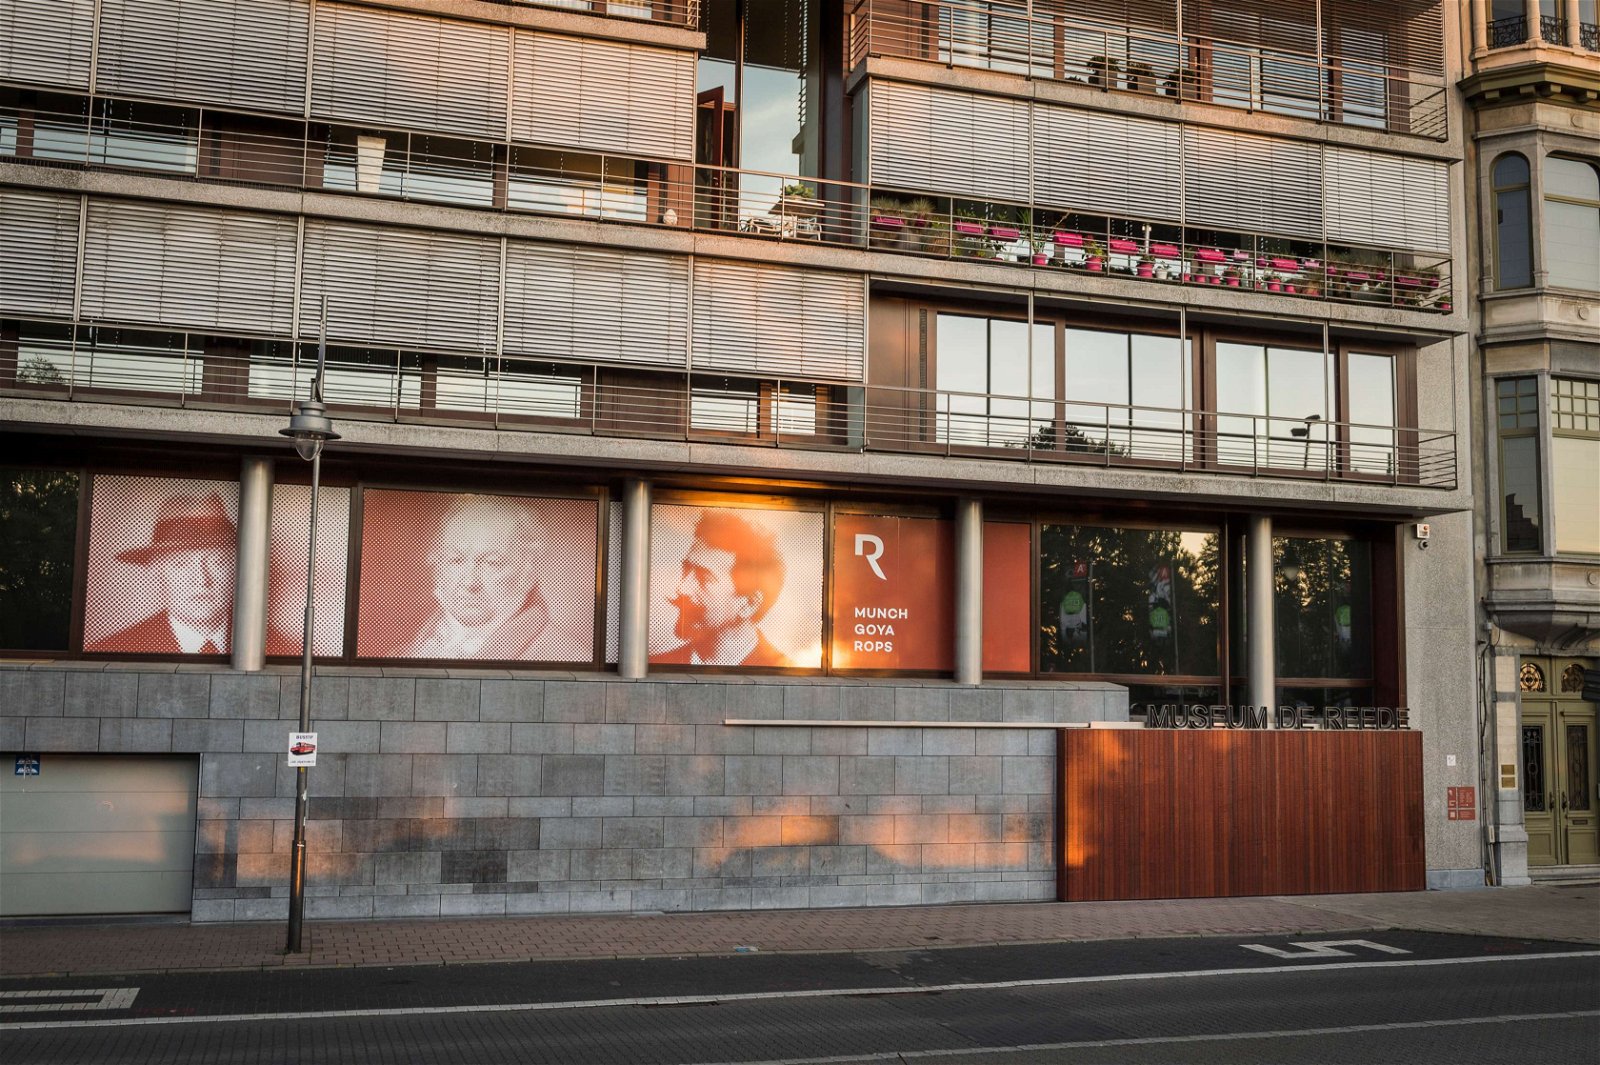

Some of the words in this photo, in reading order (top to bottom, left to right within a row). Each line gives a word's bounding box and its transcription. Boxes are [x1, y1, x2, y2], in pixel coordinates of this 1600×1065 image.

[855, 534, 887, 580] R
[854, 607, 908, 619] MUNCH
[854, 624, 895, 636] GOYA
[854, 640, 893, 653] ROPS
[1147, 704, 1268, 729] MUSEUM
[1277, 705, 1314, 729] DE
[1323, 706, 1411, 730] REEDE
